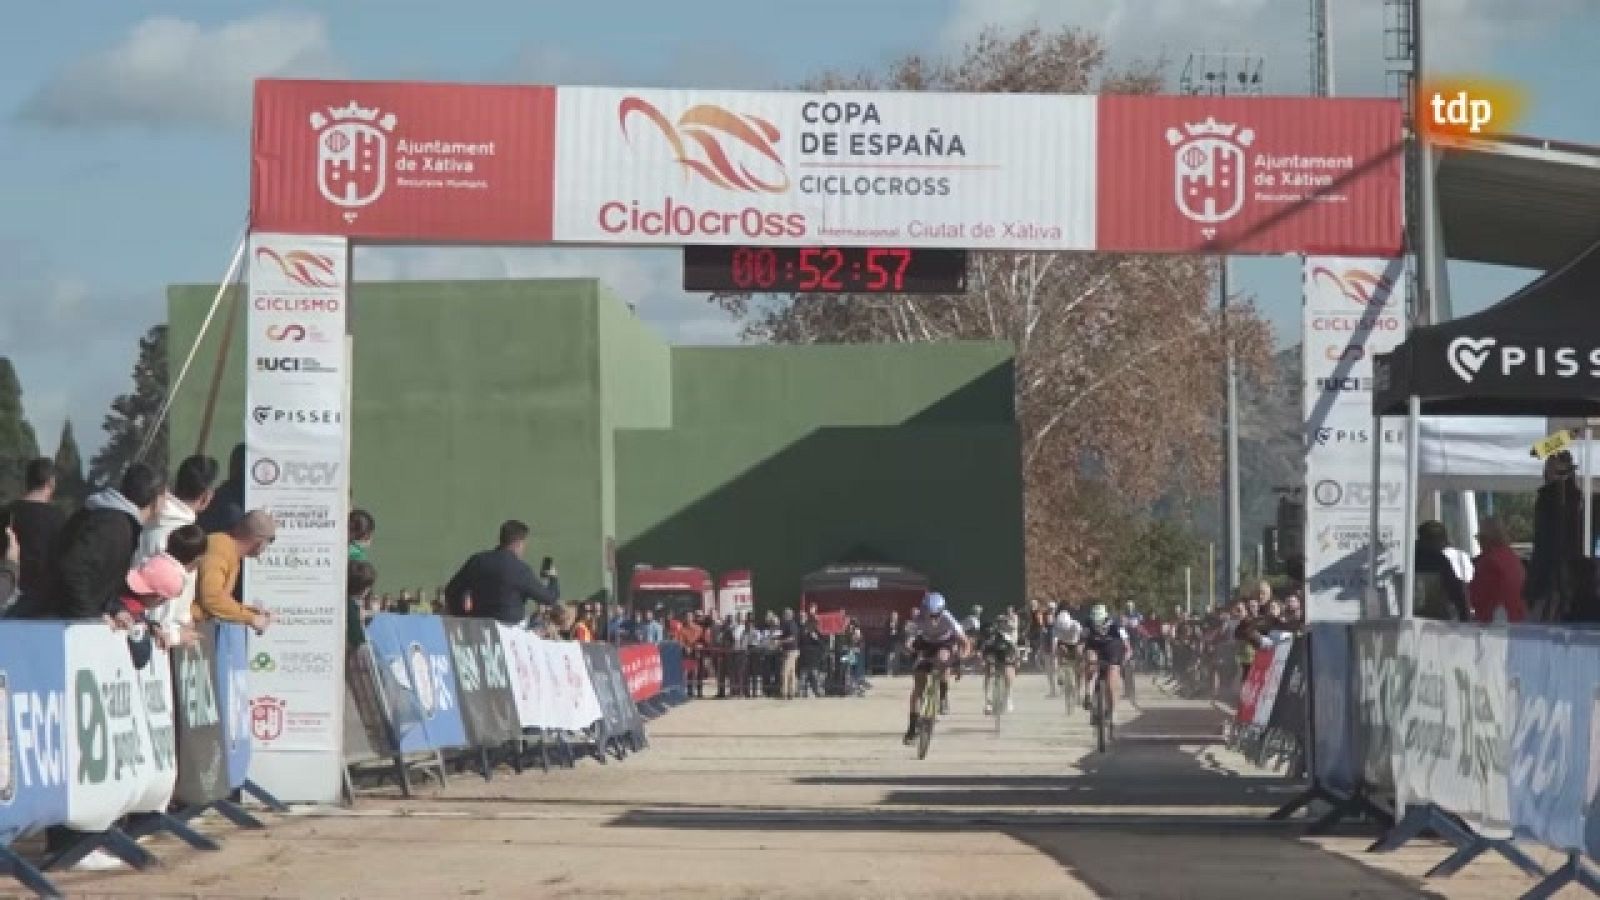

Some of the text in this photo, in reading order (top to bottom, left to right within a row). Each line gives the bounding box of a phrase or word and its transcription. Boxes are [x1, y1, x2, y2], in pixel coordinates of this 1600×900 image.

[801, 101, 881, 125] COPA
[396, 139, 496, 156] Ajuntament
[801, 127, 966, 157] DE ESPAÑA
[395, 155, 417, 171] de
[1254, 154, 1354, 170] Ajuntament
[799, 175, 951, 196] CICLOCROSS
[1254, 172, 1275, 186] de
[907, 219, 965, 239] Ciutat
[970, 221, 995, 239] de
[254, 297, 340, 311] CICLISMO
[1312, 317, 1399, 331] CICLISMO
[264, 357, 299, 371] UCI
[274, 409, 340, 424] PISSEI
